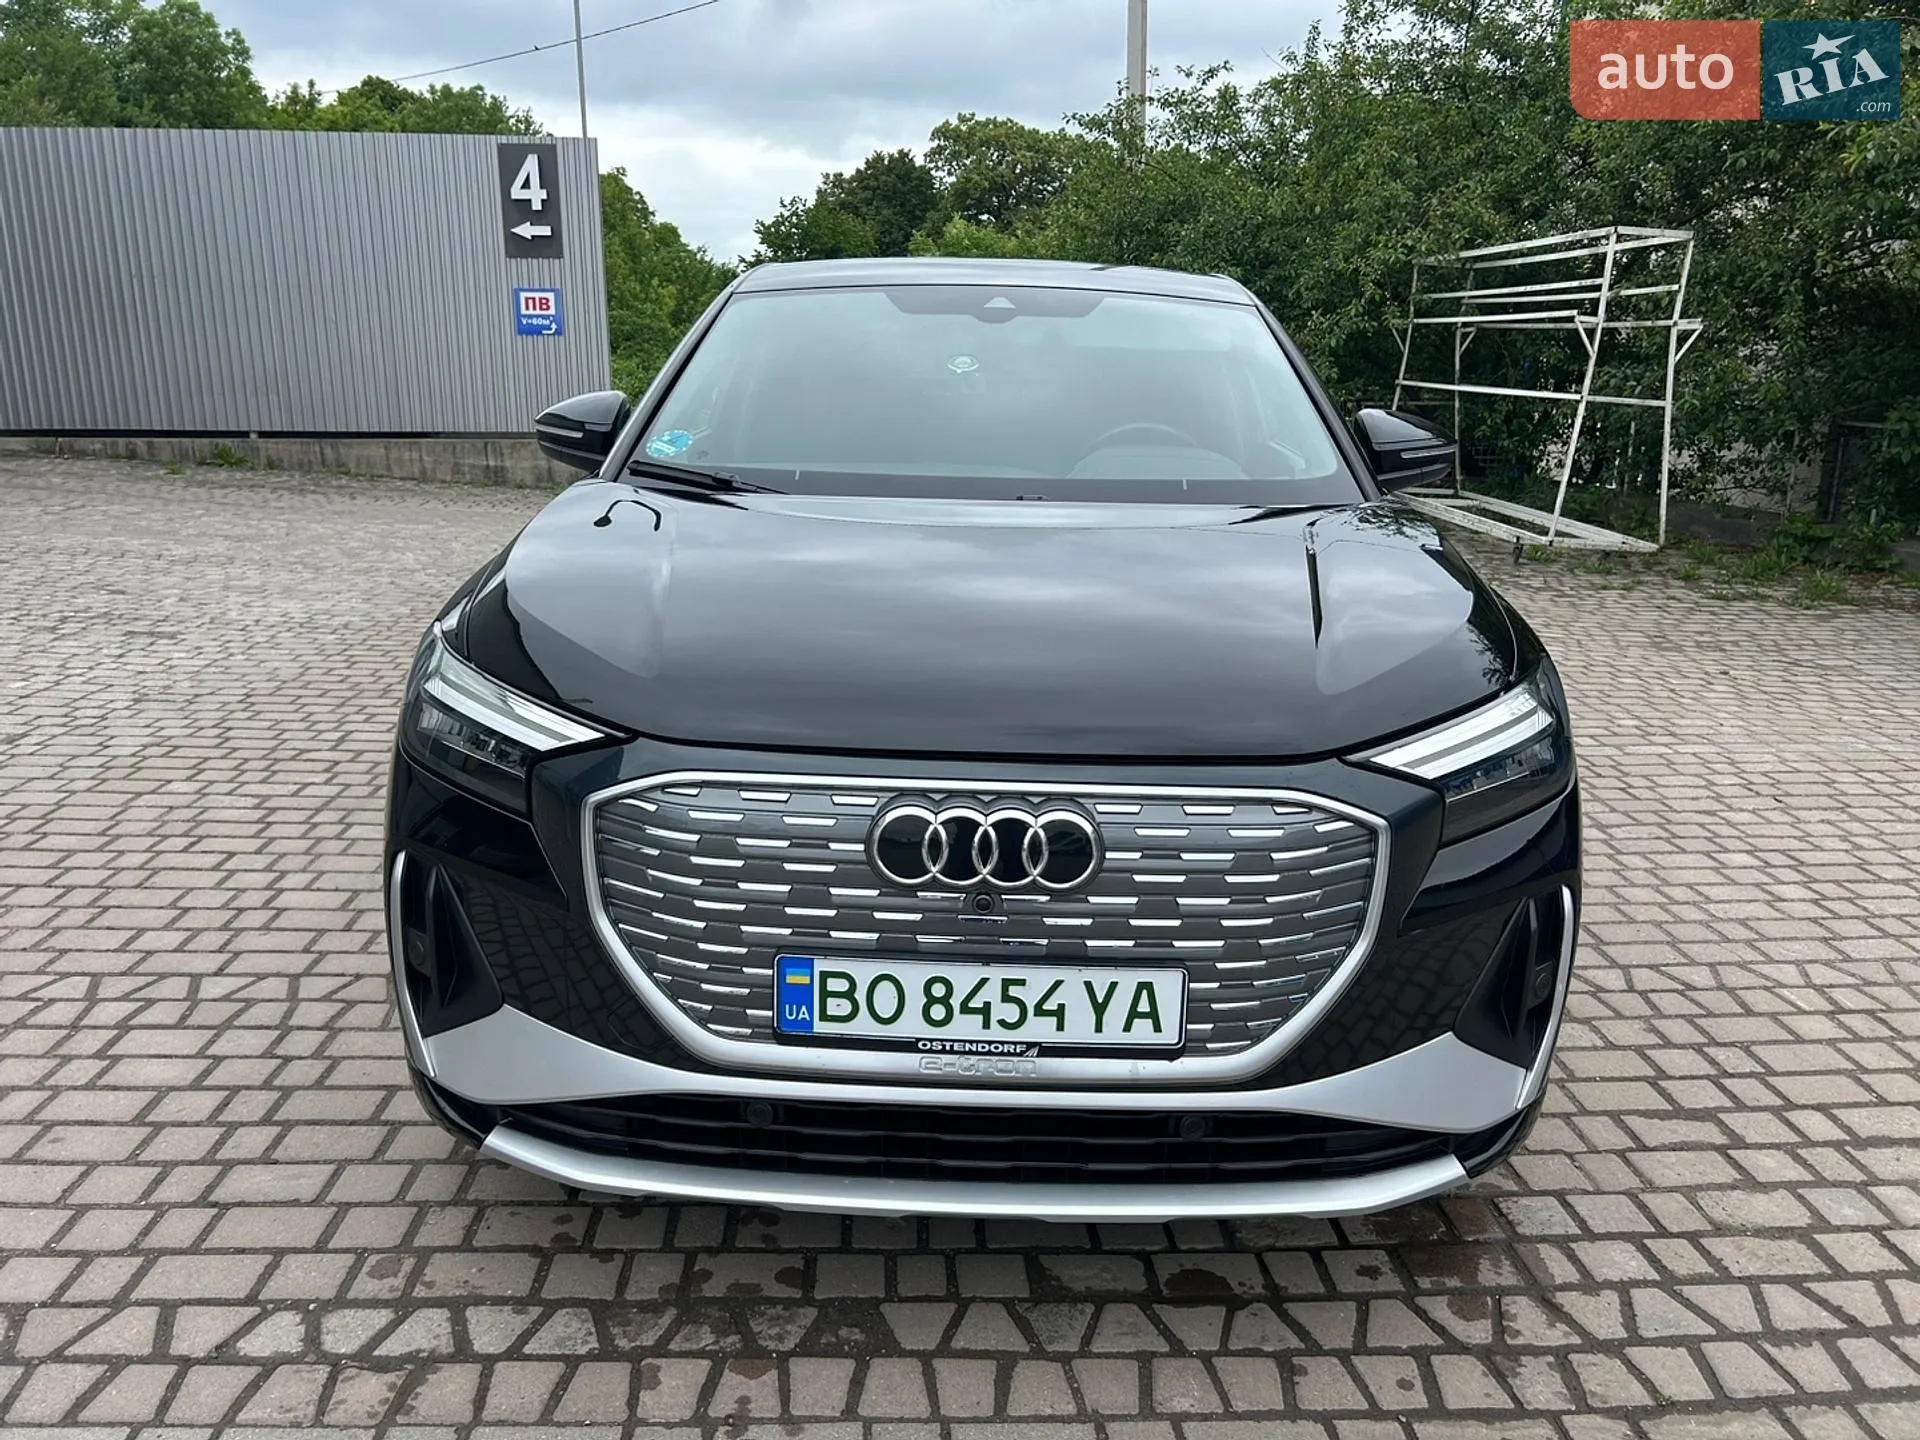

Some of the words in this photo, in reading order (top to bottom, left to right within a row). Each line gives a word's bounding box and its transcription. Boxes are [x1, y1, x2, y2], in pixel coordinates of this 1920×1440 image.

[510, 153, 548, 211] 4
[524, 296, 551, 312] ПВ
[818, 970, 906, 1026] BO
[921, 975, 1066, 1032] 8454
[1084, 980, 1163, 1034] YA
[785, 1004, 811, 1022] UA
[917, 1040, 1027, 1054] OSTENDORF
[919, 1055, 1037, 1077] e-tron
